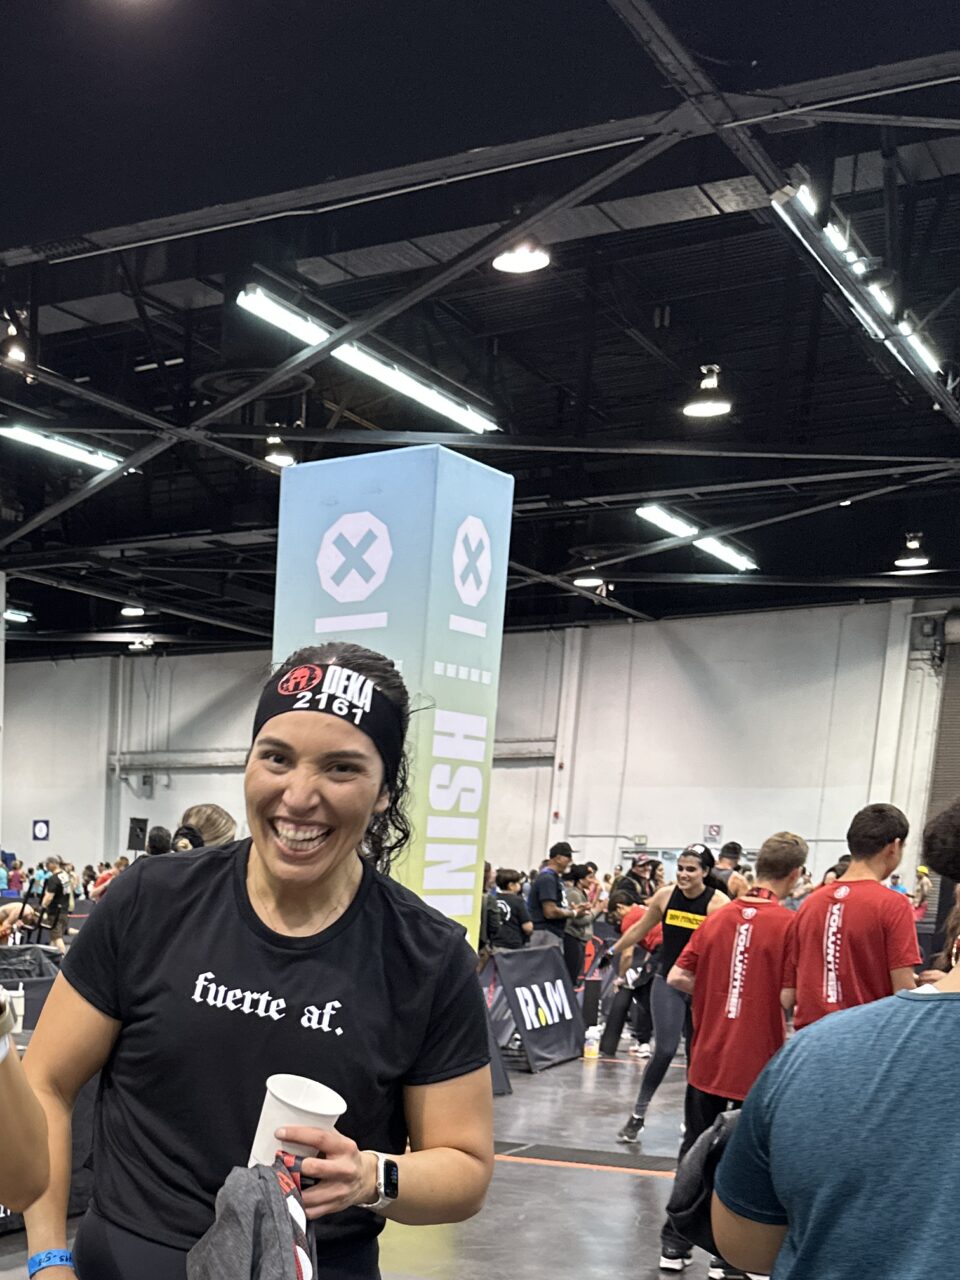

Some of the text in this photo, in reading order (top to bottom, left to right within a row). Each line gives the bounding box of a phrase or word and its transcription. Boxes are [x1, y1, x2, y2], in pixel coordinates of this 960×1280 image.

[292, 691, 364, 725] 2161
[321, 664, 374, 713] DEKA
[420, 709, 488, 917] INISH
[191, 971, 344, 1036] fuerte af.
[514, 978, 574, 1031] RAM
